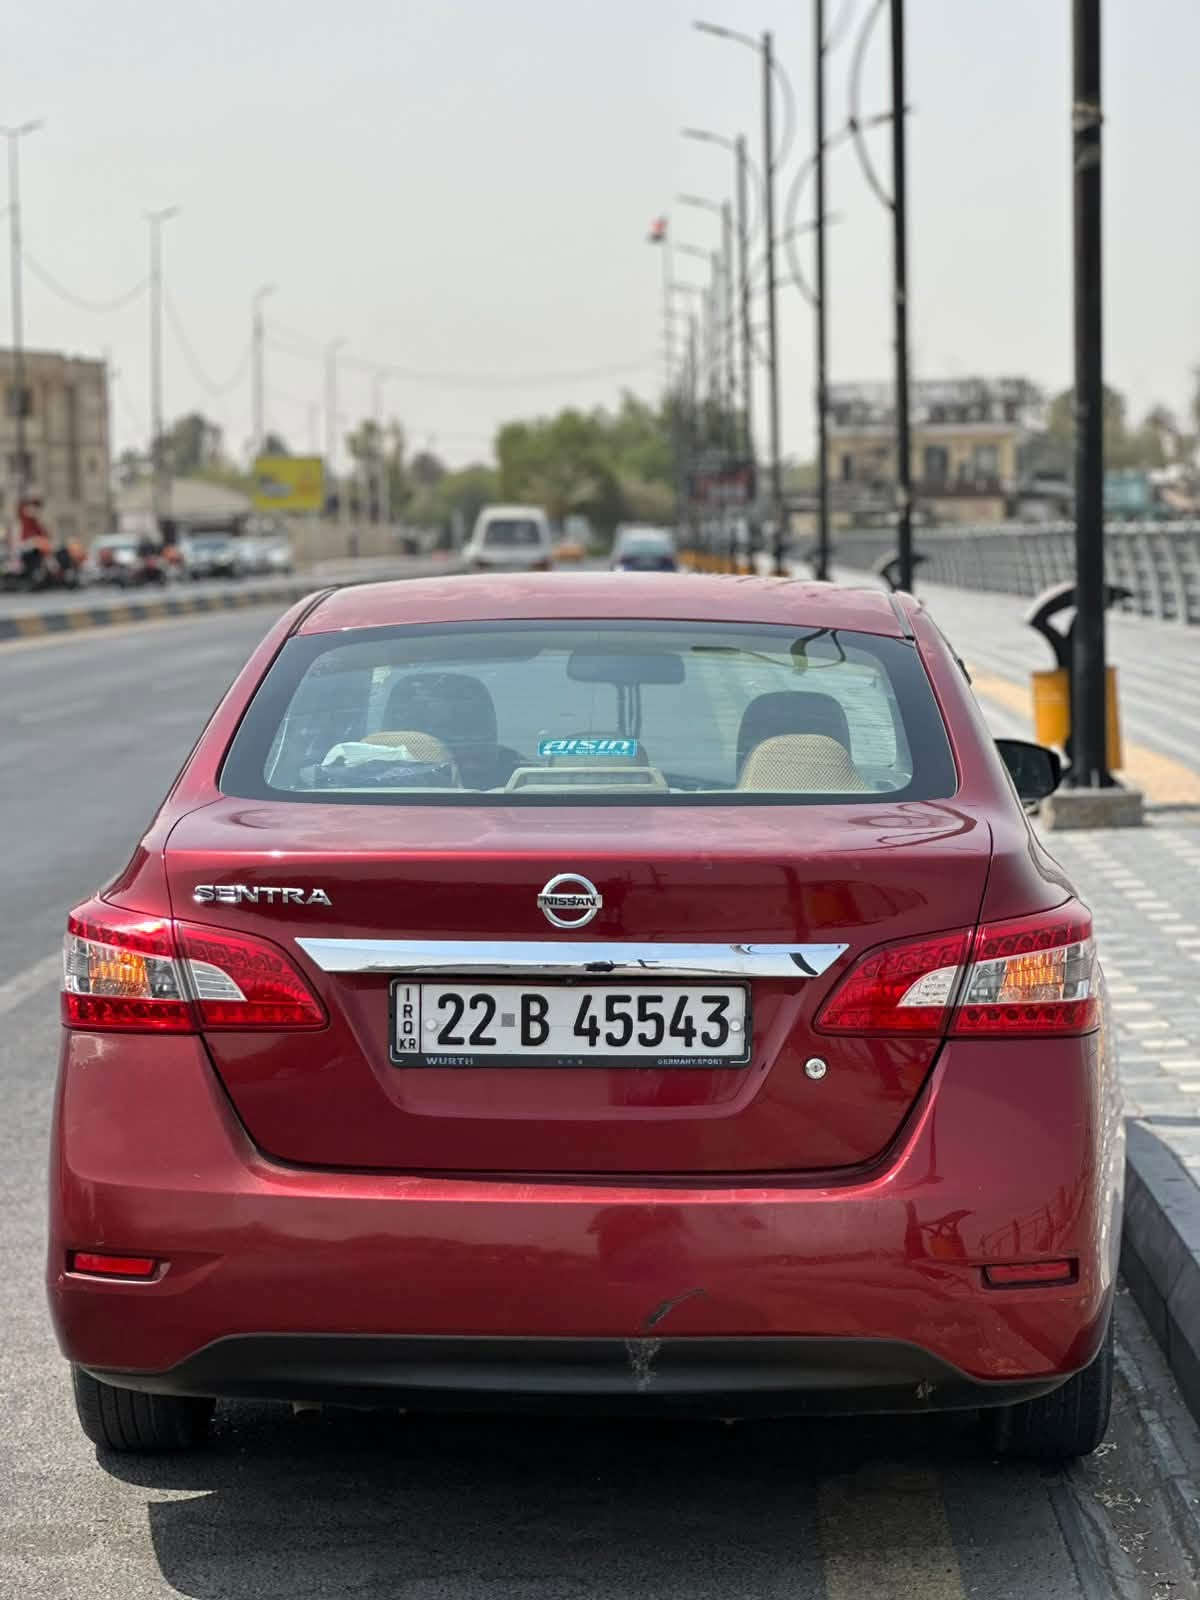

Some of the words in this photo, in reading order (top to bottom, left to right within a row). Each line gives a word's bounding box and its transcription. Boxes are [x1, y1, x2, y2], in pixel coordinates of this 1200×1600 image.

[193, 884, 333, 906] SENTRA
[543, 896, 597, 906] NISSAN
[437, 993, 497, 1046] 22
[520, 993, 550, 1047] B
[573, 995, 730, 1048] 45543
[399, 1038, 417, 1049] KR
